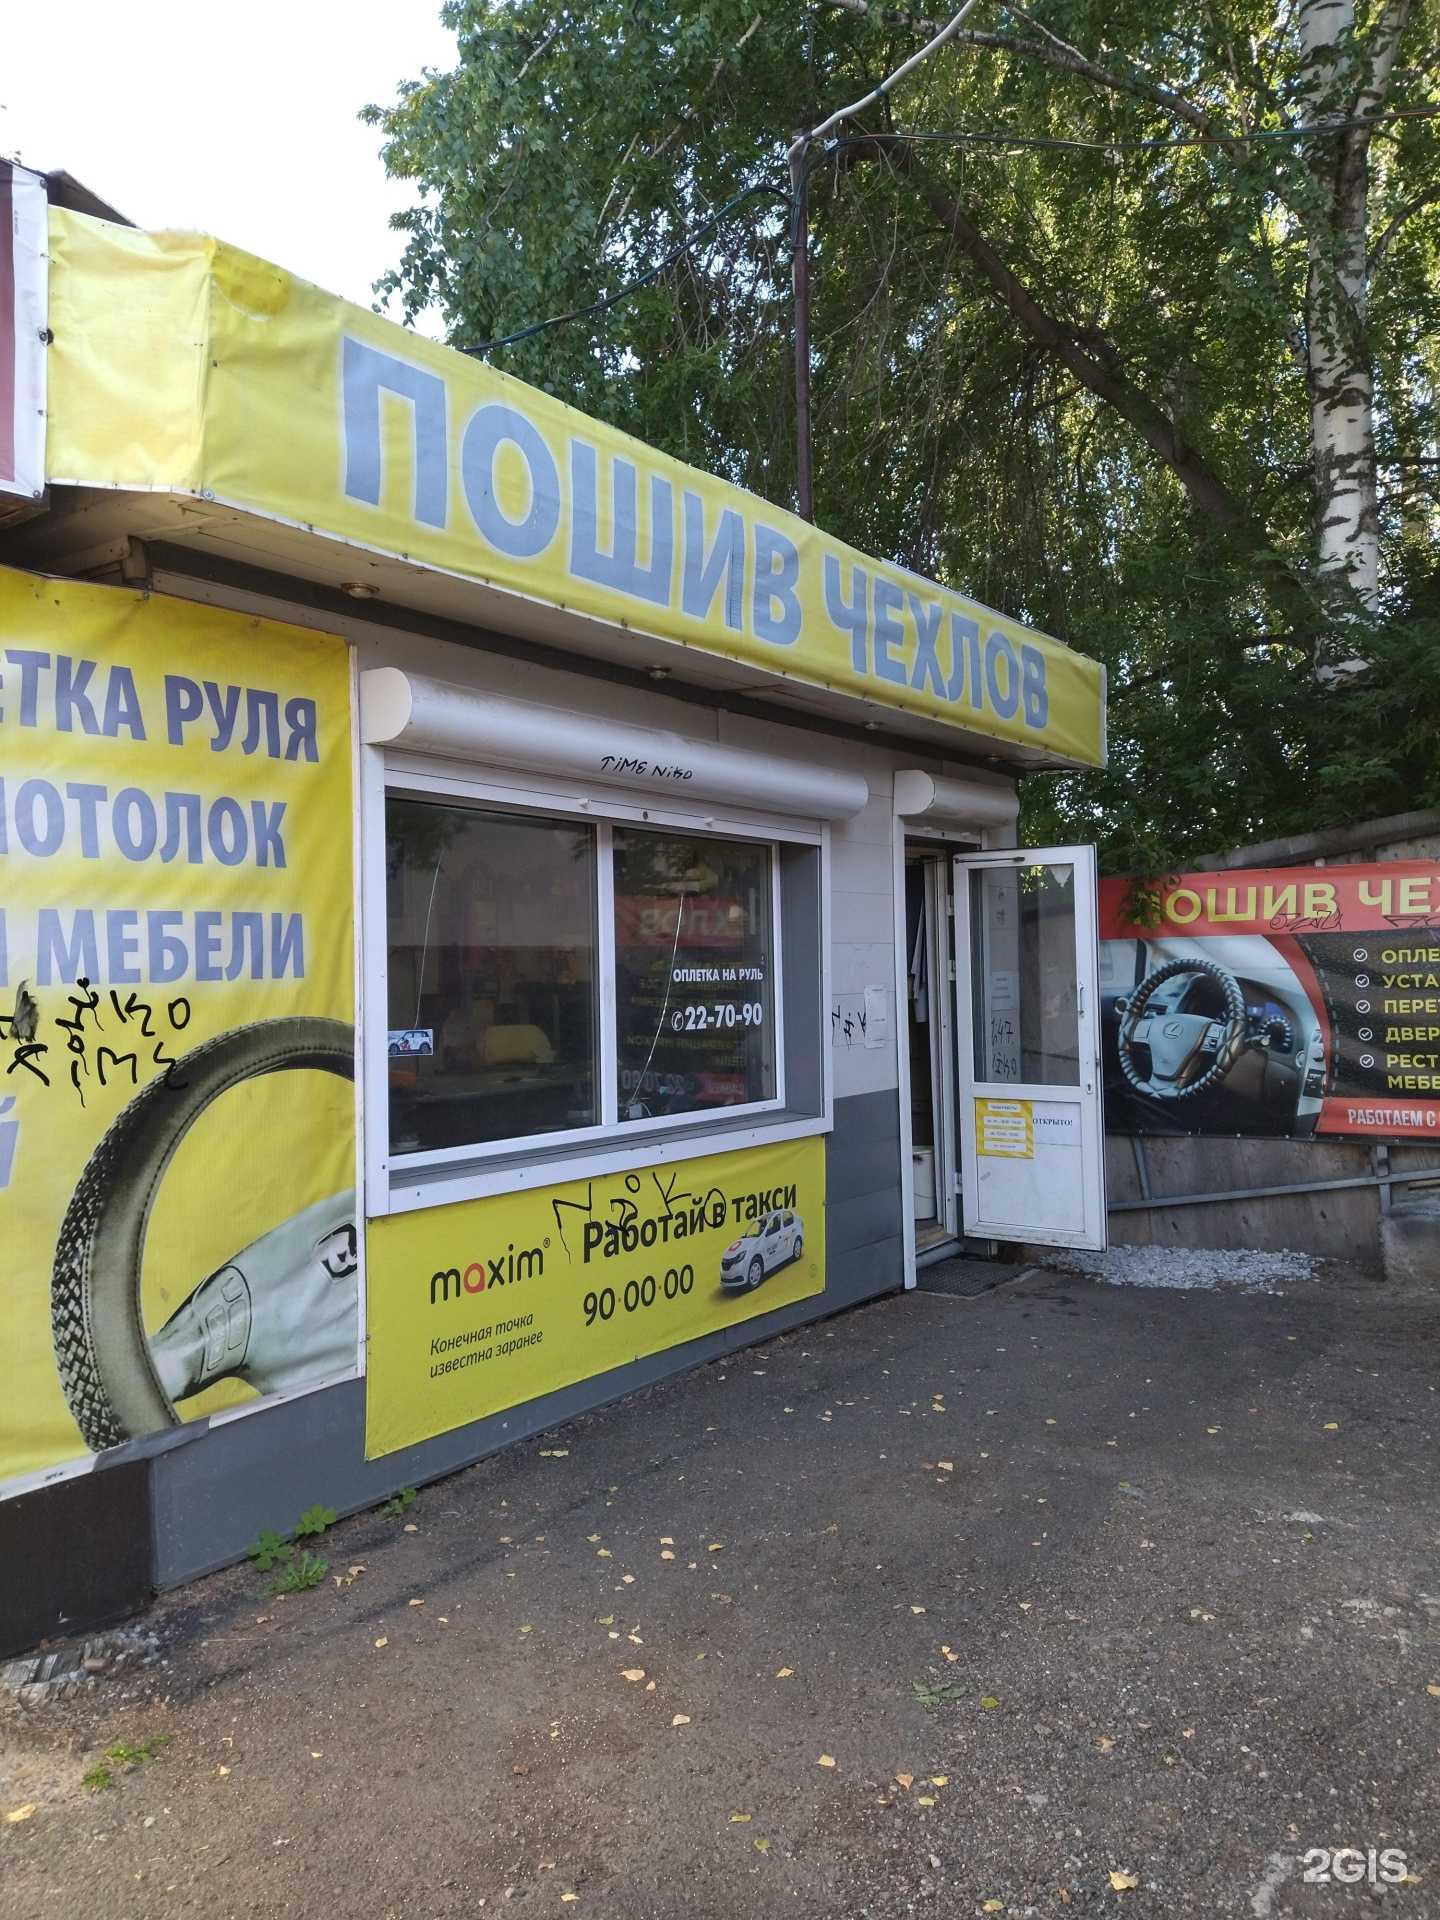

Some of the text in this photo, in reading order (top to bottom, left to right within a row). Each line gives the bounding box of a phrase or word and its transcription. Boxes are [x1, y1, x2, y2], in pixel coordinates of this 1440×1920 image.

[342, 335, 1049, 729] ПОШИВ ЧЕХЛОВ
[0, 649, 320, 763] ТКА РУЛЯ
[0, 777, 288, 869] ОТОЛОК
[1137, 883, 1338, 924] ОШИВ
[36, 908, 305, 986] МЕБЕЛИ
[1381, 948, 1440, 963] ОПЛЕ
[673, 967, 763, 982] ОПЛЕТКА НА РУЛЬ
[1382, 974, 1440, 989] УСТА
[685, 1003, 762, 1030] 22-70-90
[1384, 999, 1440, 1014] ПЕРЕ
[1385, 1027, 1440, 1043] ДВЕР
[1387, 1054, 1440, 1068] РЕСТ
[1348, 1109, 1422, 1127] РАБОТАЕМ
[583, 1184, 797, 1264] Работай в такси
[430, 1313, 533, 1357] Конечная точка
[430, 1331, 543, 1378] известна заранее
